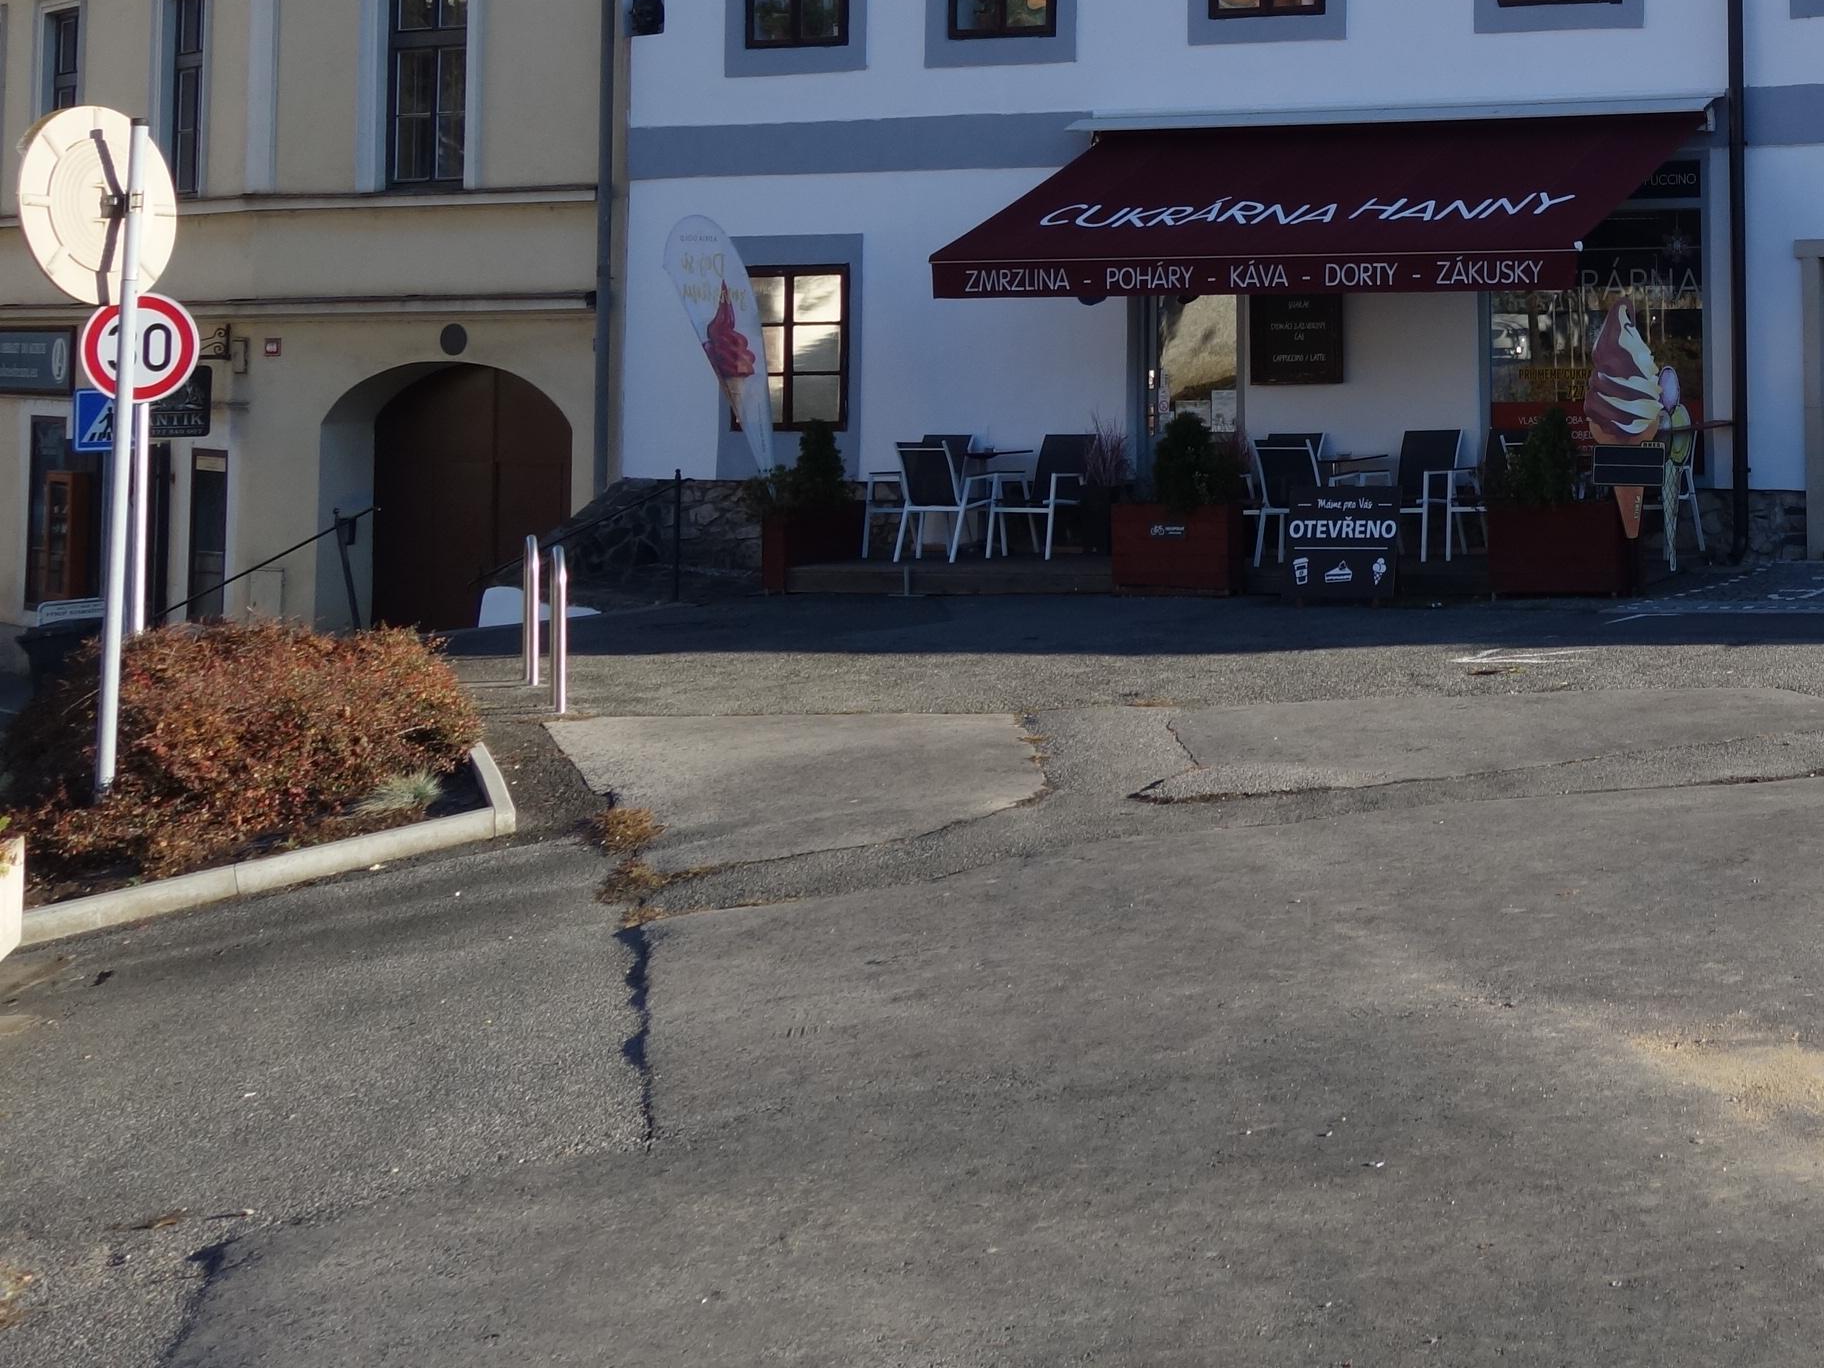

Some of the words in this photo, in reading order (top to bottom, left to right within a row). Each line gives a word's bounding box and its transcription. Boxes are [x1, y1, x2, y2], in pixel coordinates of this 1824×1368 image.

[1039, 195, 1338, 228] CUKRÁRNA
[1348, 192, 1576, 222] HANNY
[965, 266, 1071, 292] ZMRZLINA
[1106, 261, 1194, 290] POHÁRY
[1230, 260, 1289, 288] KÁVA
[1325, 262, 1398, 287] DORTY
[1436, 255, 1544, 285] ZÁKUSKY
[1580, 257, 1703, 299] RÁRNA
[1316, 498, 1342, 510] Máme
[1342, 499, 1357, 512] pro
[1358, 496, 1374, 510] Vás
[1288, 515, 1397, 539] OTEVŘENO
